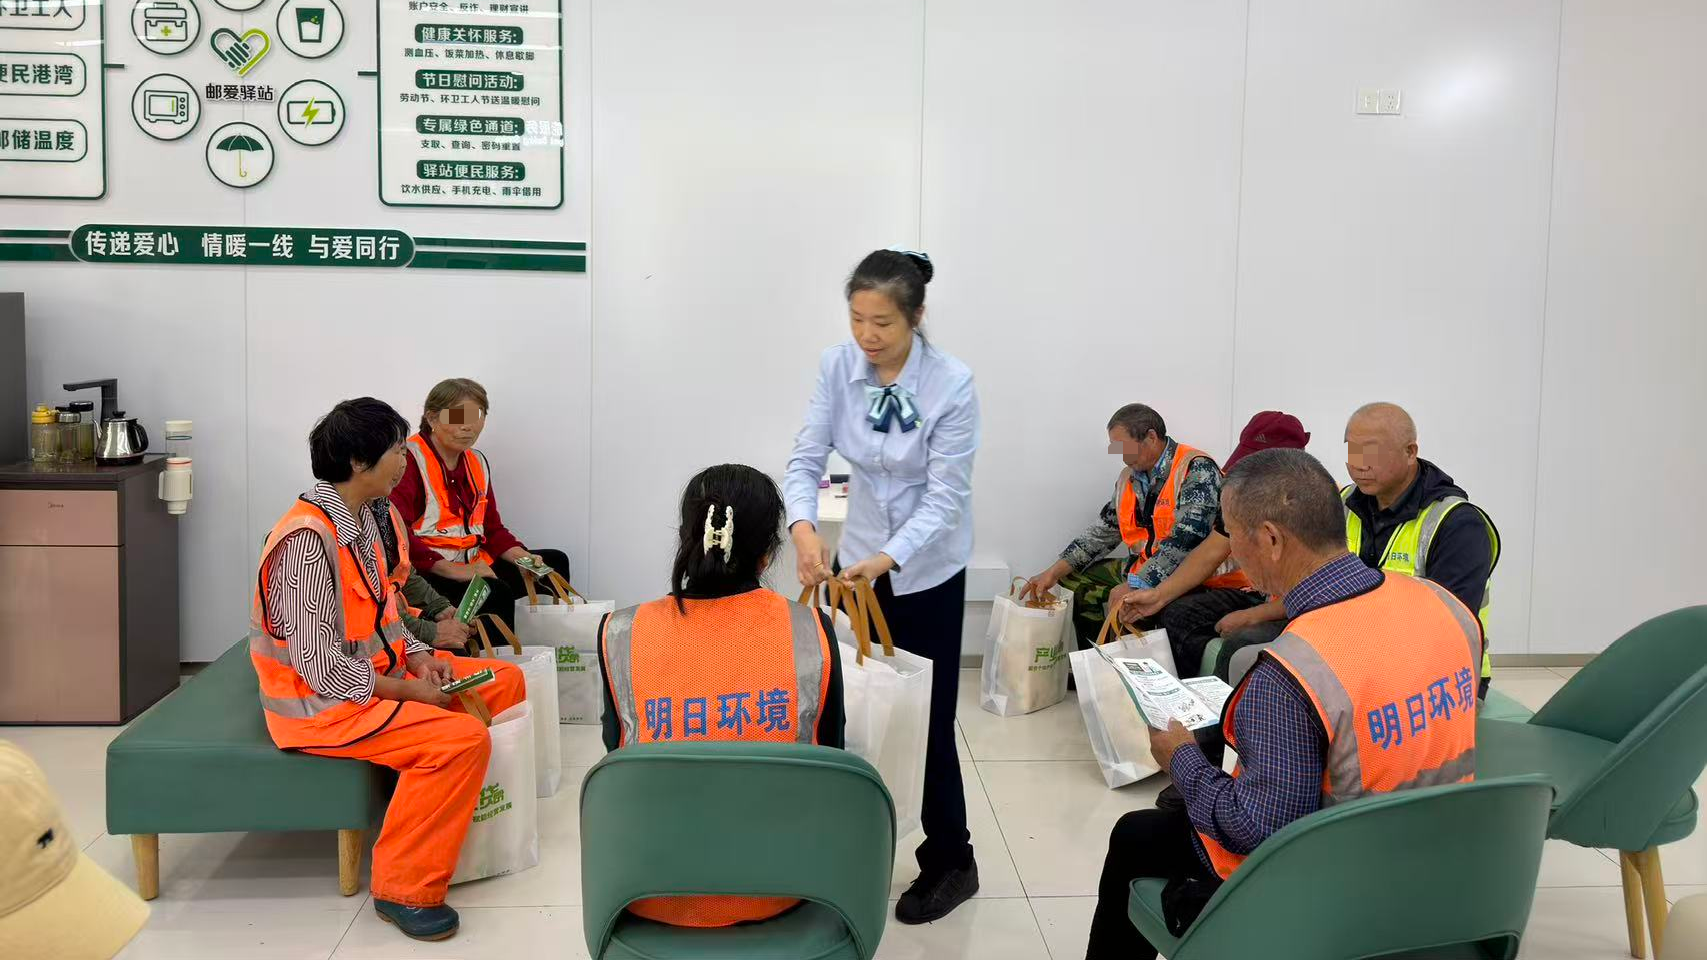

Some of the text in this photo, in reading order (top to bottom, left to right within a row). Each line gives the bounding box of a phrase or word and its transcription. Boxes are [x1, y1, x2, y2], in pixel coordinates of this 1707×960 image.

[205, 83, 274, 101] 邮爱驿站
[85, 230, 401, 261] 传递爱心 情暖一线 与爱同行
[645, 688, 791, 740] 明日环境
[1367, 666, 1473, 750] 明日环境
